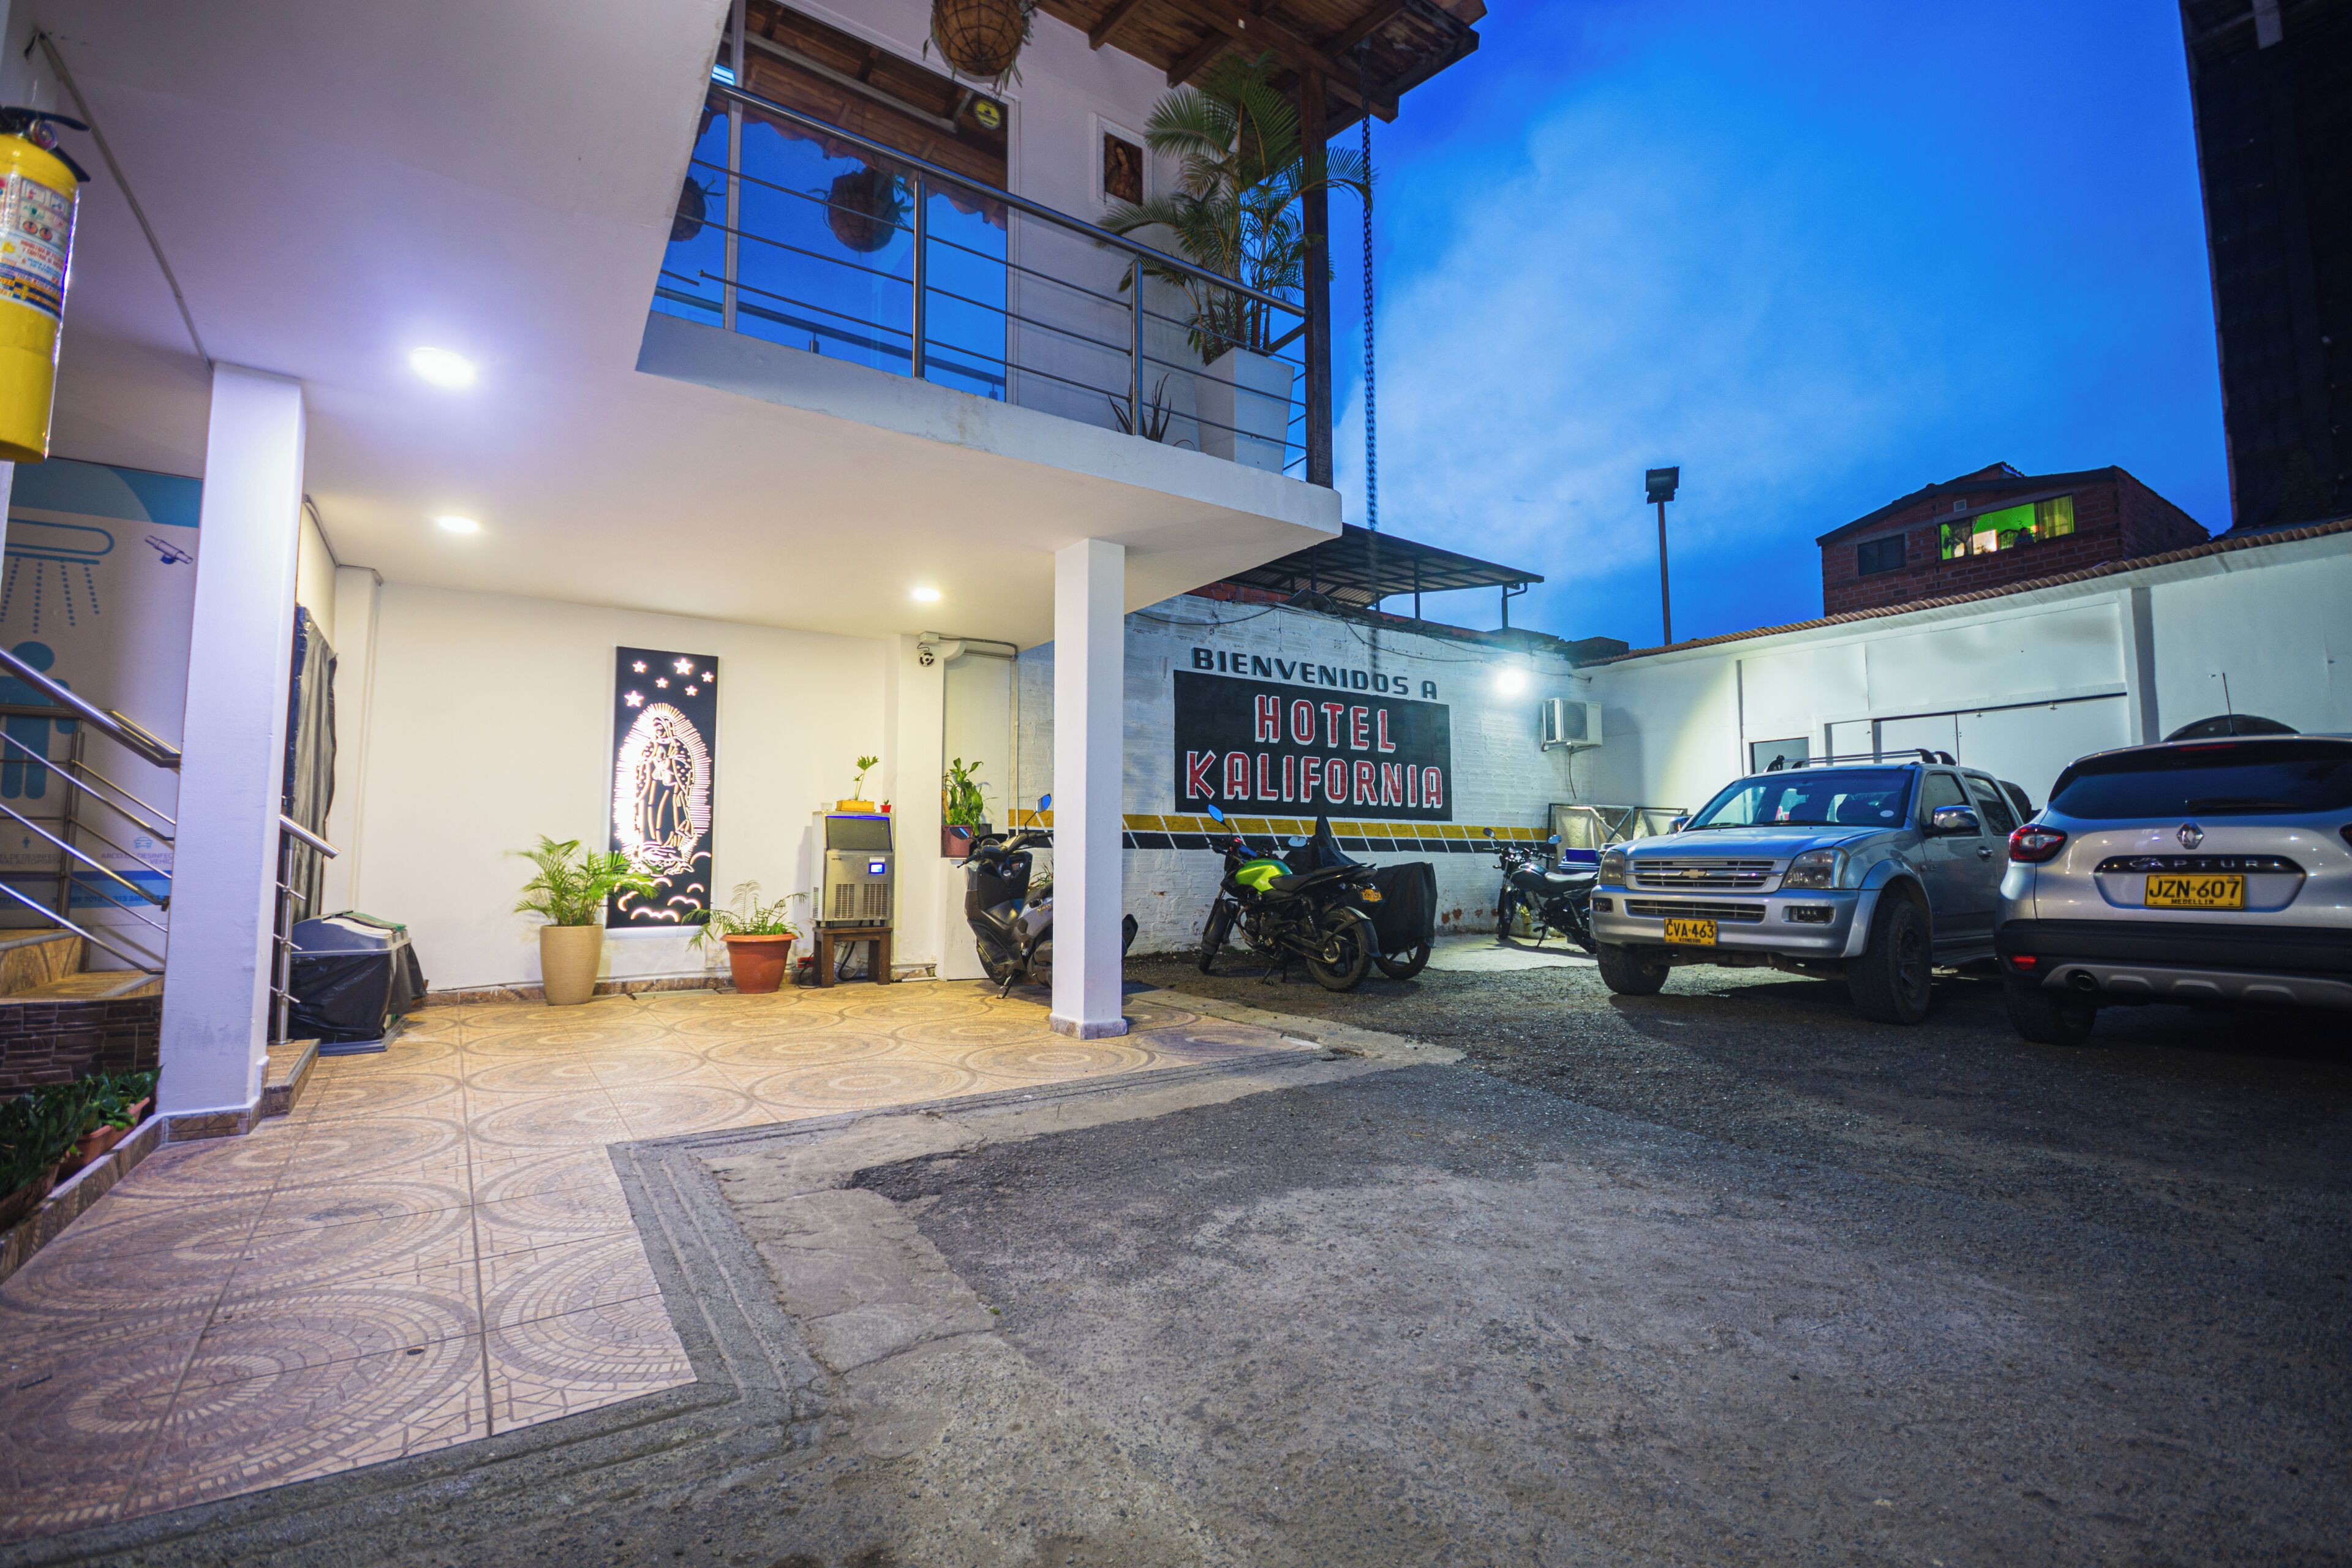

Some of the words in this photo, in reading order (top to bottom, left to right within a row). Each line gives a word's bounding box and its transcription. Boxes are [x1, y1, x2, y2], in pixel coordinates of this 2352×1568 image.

[1191, 647, 1409, 695] BIENVENIDOS
[1421, 680, 1437, 700] A
[1254, 695, 1396, 753] HOTEL
[1186, 750, 1443, 809] KALIFORNIA
[2129, 859, 2259, 868] CAPTUR
